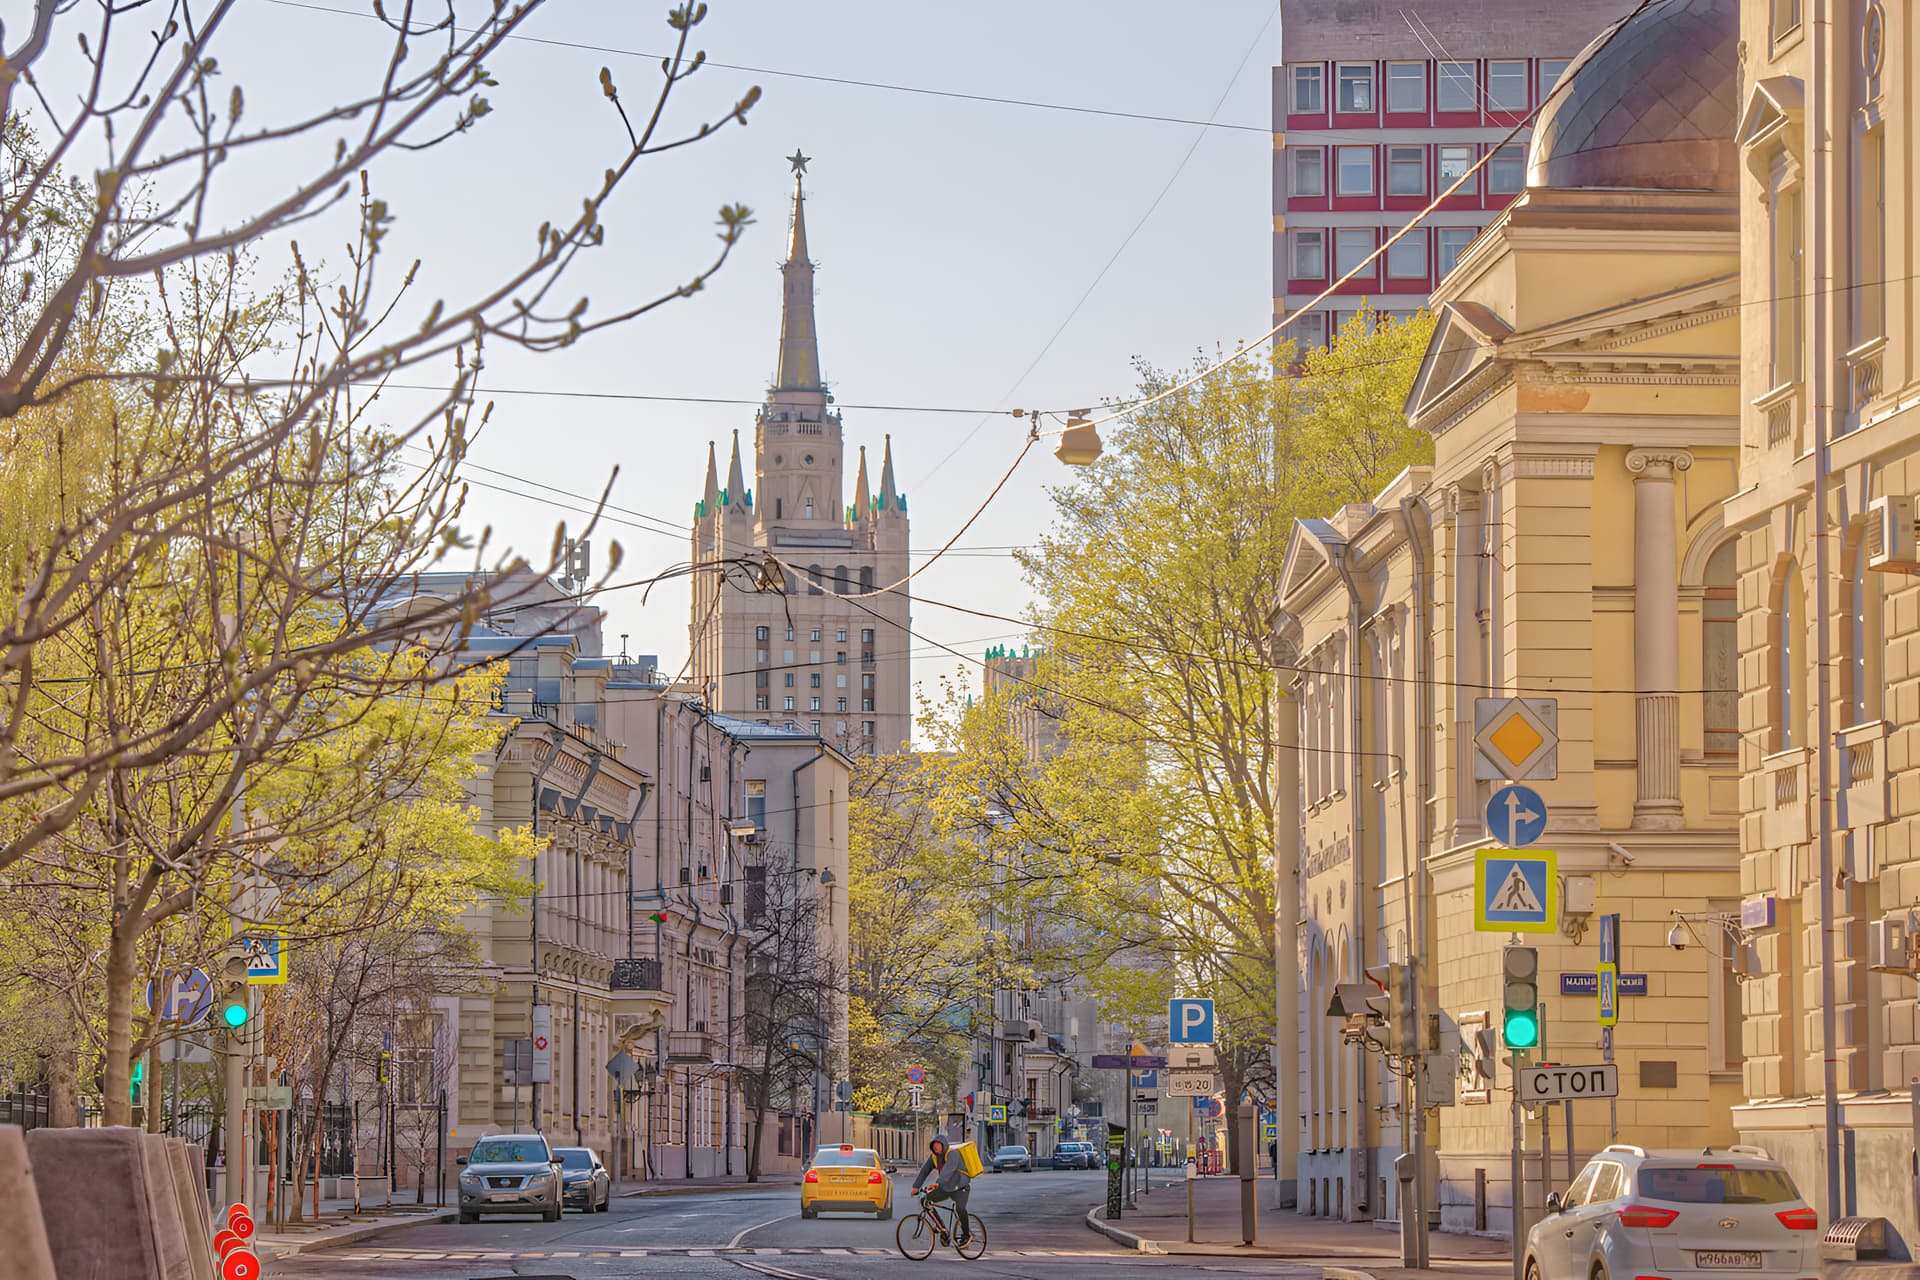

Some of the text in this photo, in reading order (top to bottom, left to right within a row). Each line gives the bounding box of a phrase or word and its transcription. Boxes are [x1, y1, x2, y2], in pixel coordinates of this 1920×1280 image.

[1182, 1003, 1205, 1039] P
[1196, 1080, 1209, 1090] 20
[1534, 1071, 1605, 1094] СТОП
